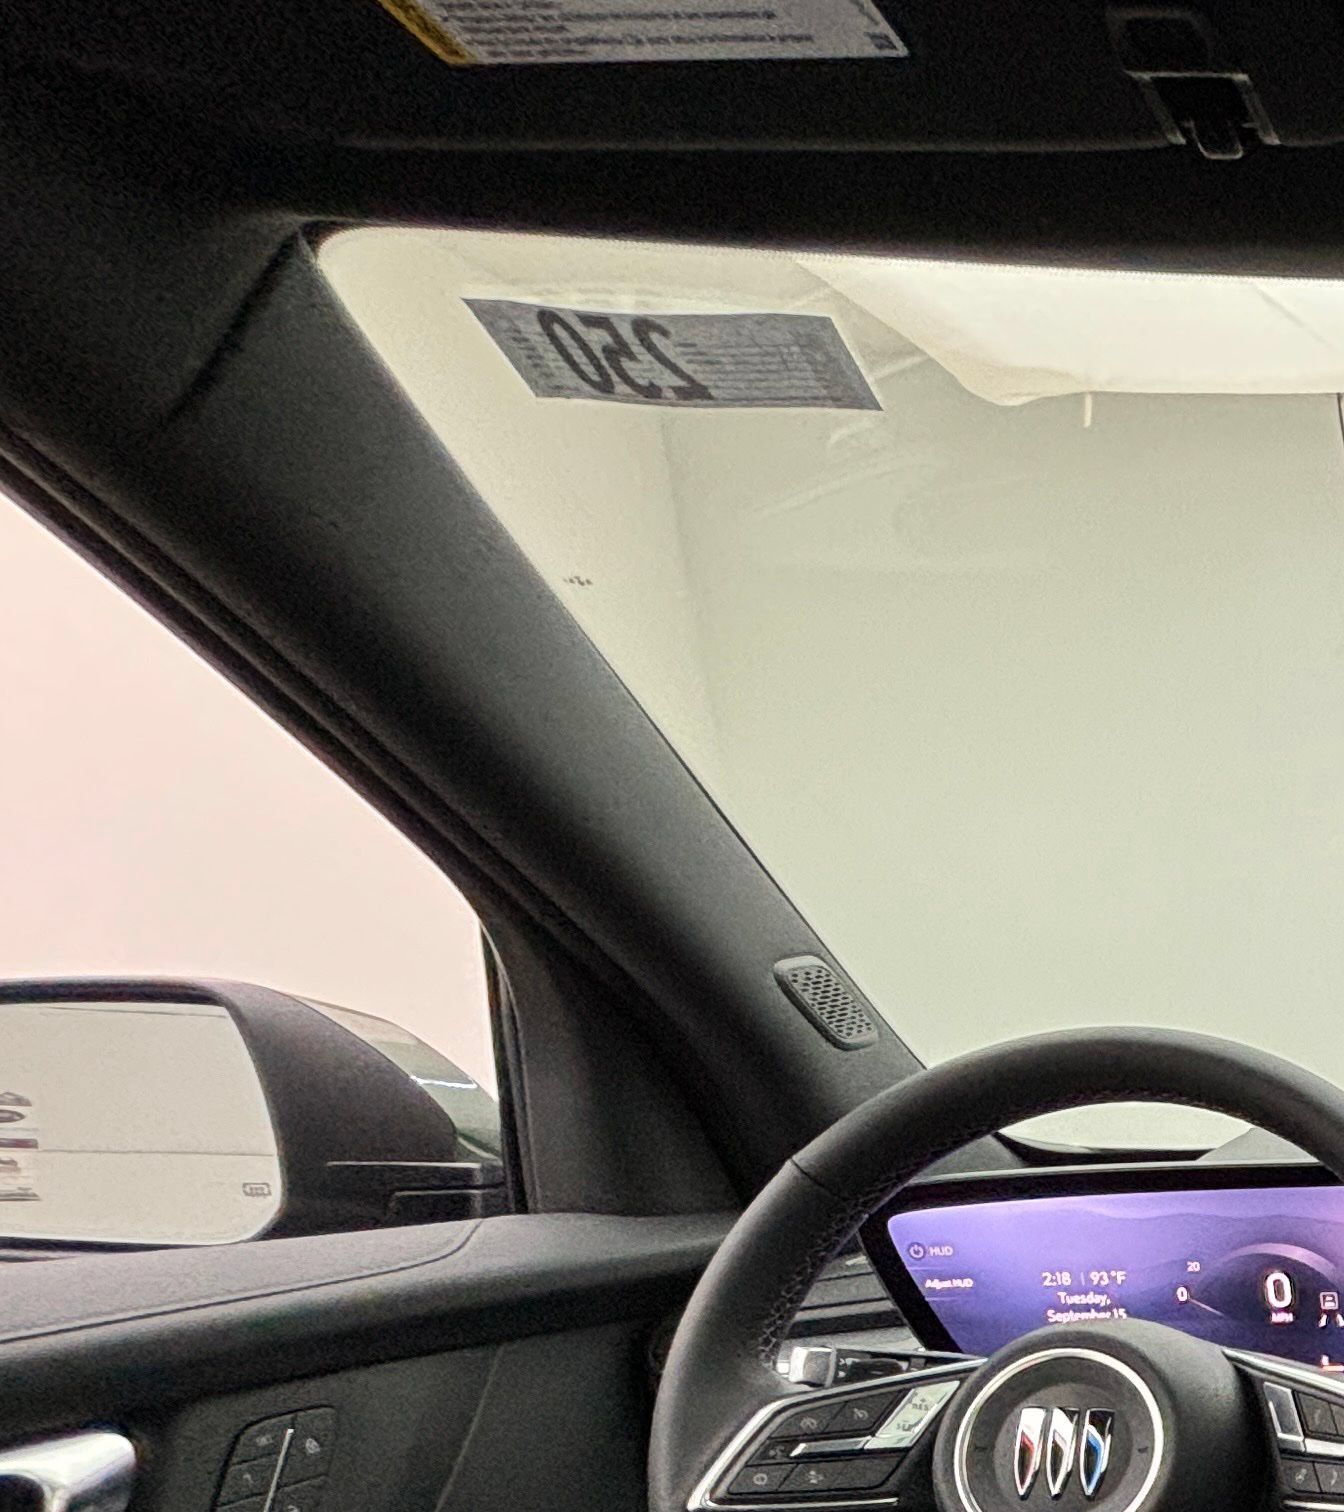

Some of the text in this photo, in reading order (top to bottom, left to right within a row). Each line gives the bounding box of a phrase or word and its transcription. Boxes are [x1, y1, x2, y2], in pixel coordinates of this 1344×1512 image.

[928, 1246, 954, 1257] HUD
[1041, 1271, 1072, 1287] 2:18
[1176, 1286, 1189, 1302] 0
[1265, 1271, 1293, 1309] 0
[1057, 1291, 1111, 1307] Tuesday,
[1046, 1309, 1110, 1324] September
